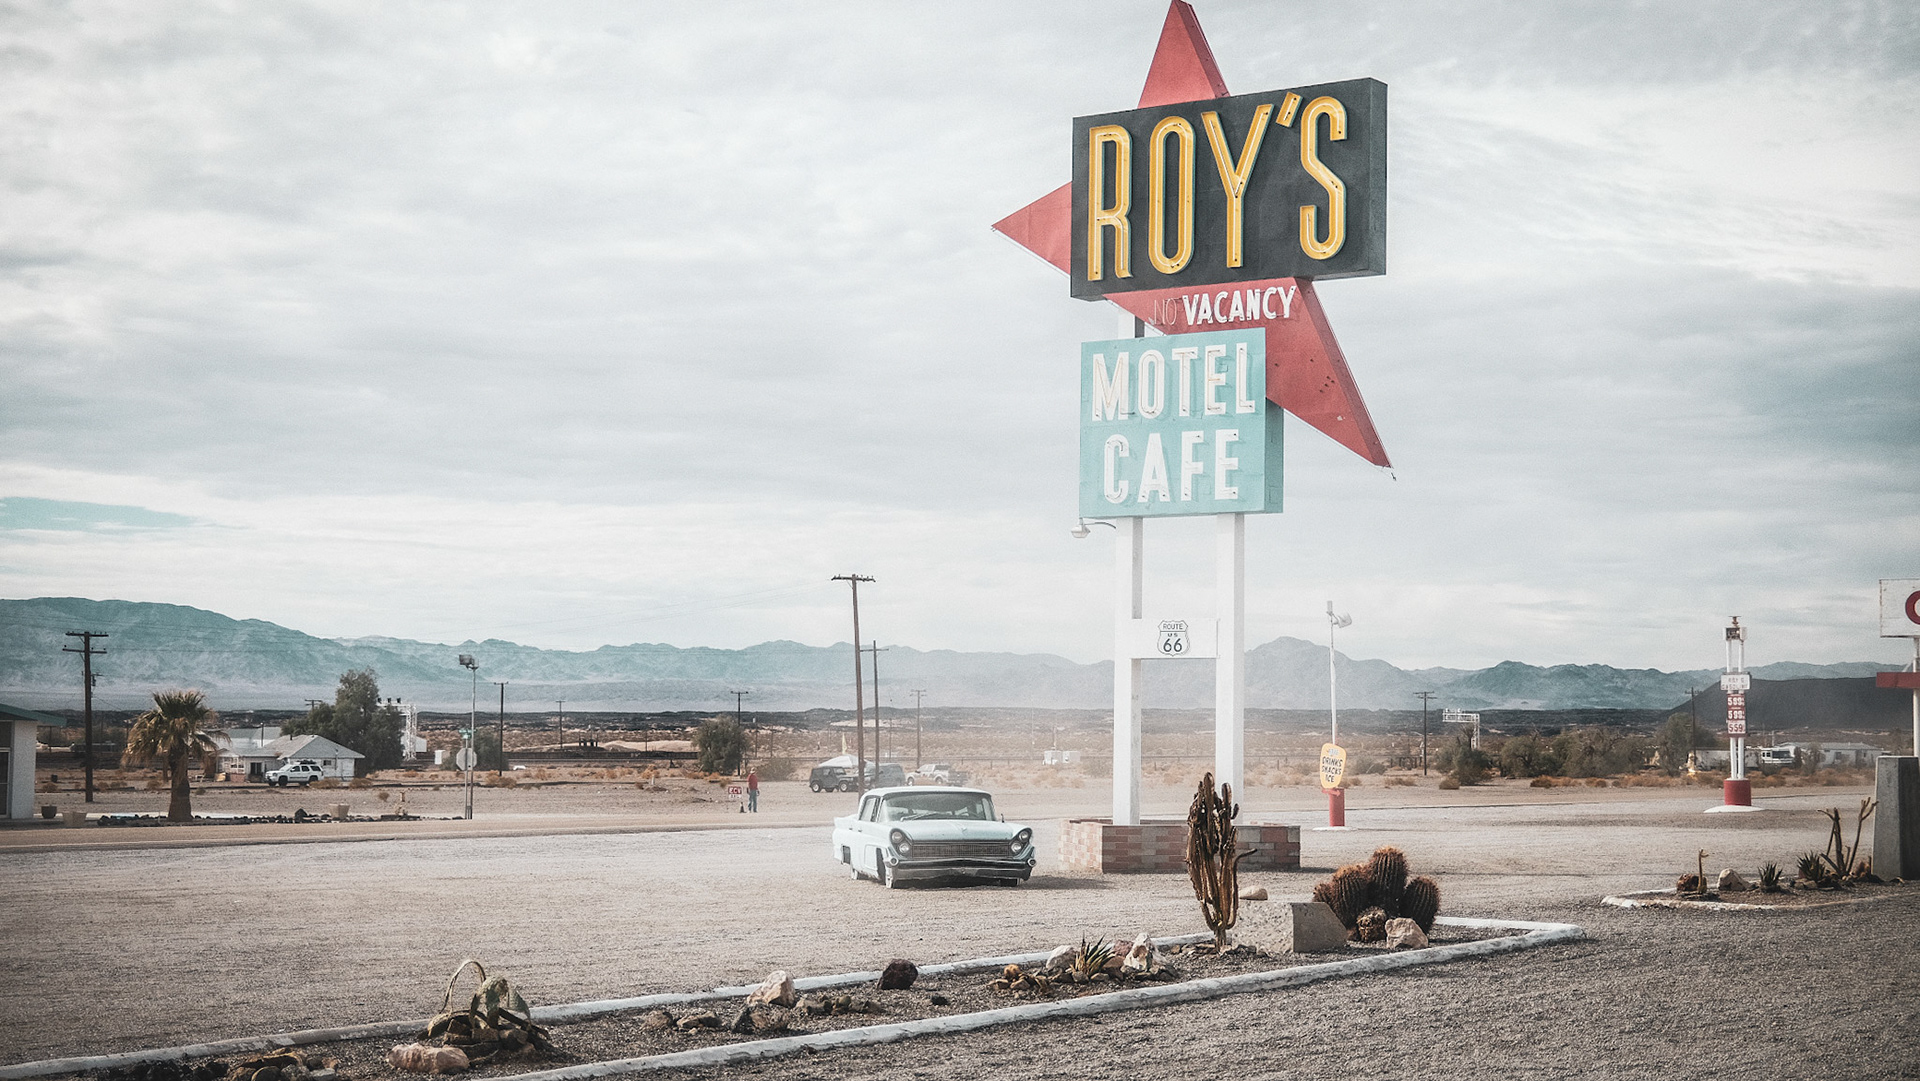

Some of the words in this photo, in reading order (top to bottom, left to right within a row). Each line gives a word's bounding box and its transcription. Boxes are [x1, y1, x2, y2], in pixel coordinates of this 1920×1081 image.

[1087, 91, 1347, 281] ROY'S
[1154, 298, 1177, 325] NO
[1182, 286, 1297, 326] VACANCY
[1092, 342, 1256, 422] MOTEL
[1104, 429, 1239, 504] CAFE
[1162, 622, 1183, 630] ROUTE
[1163, 637, 1182, 652] 66
[1321, 765, 1341, 775] SNACKS
[1322, 756, 1343, 767] DRINKS
